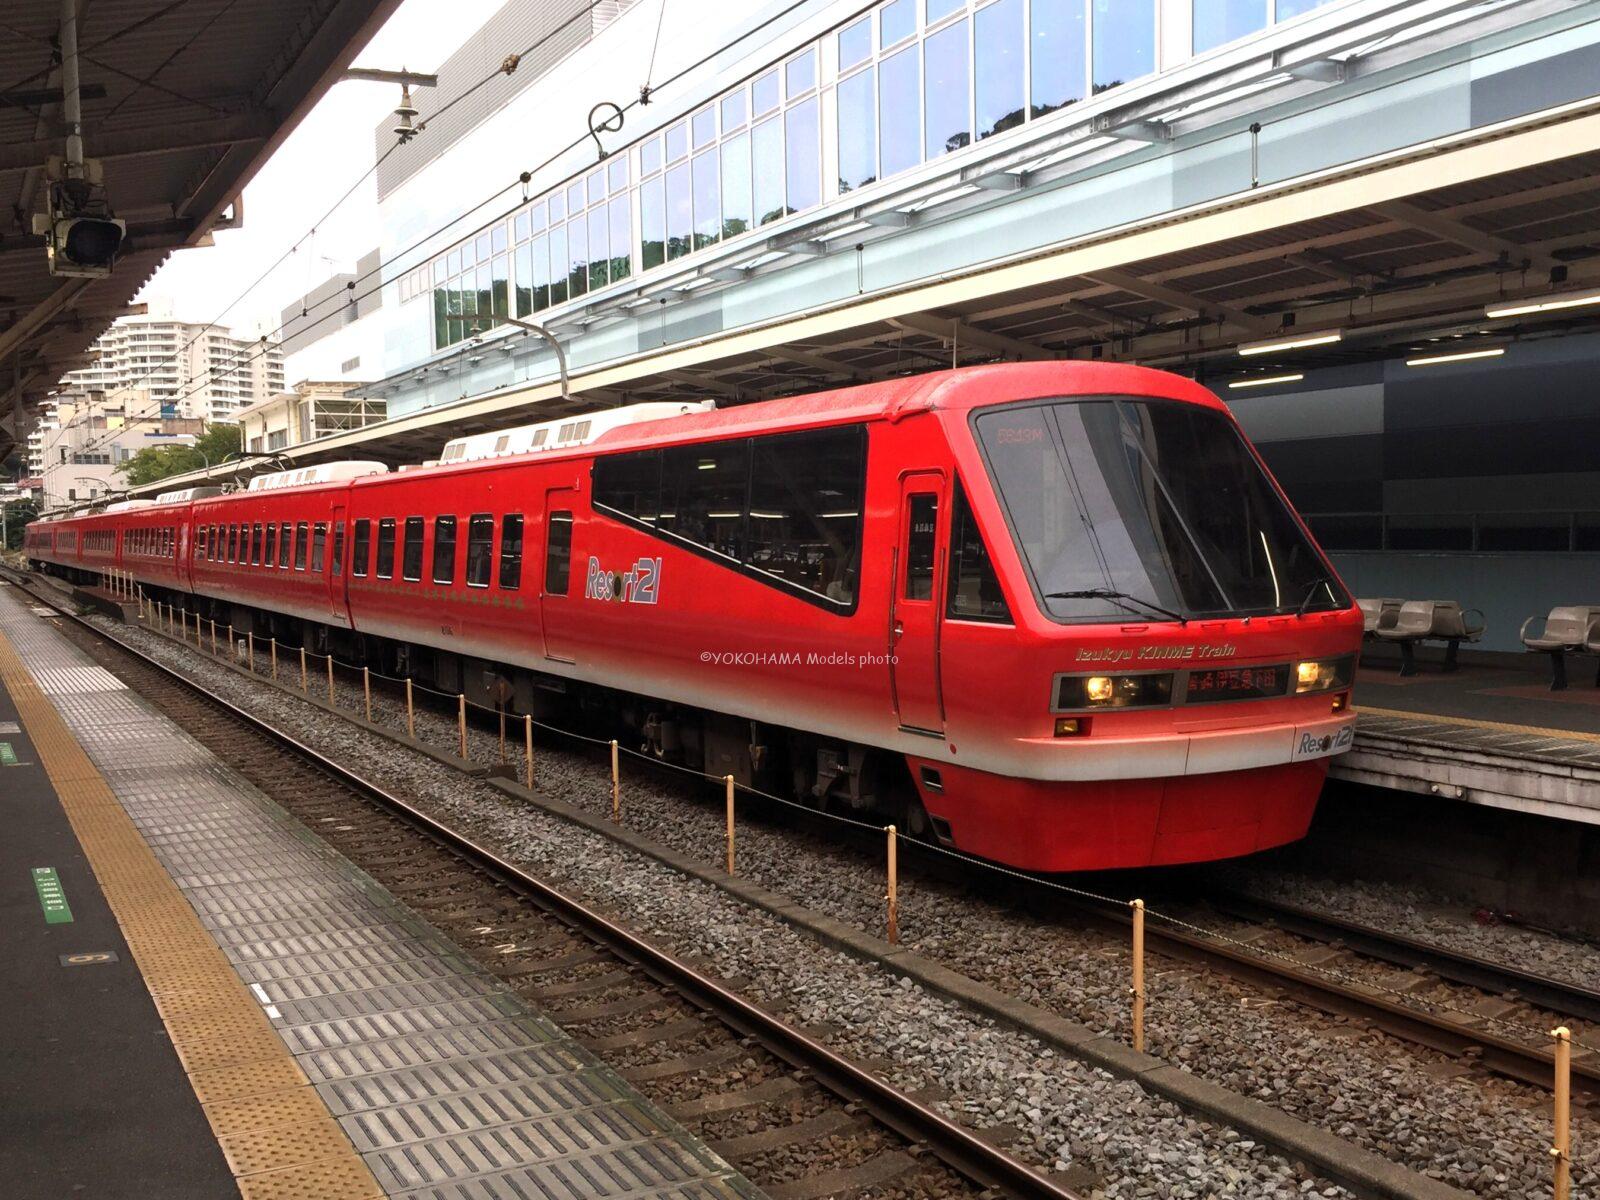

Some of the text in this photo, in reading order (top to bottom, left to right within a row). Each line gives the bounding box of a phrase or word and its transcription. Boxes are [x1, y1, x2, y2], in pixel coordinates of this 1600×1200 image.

[1075, 643, 1237, 662] Izukyu KINME Train
